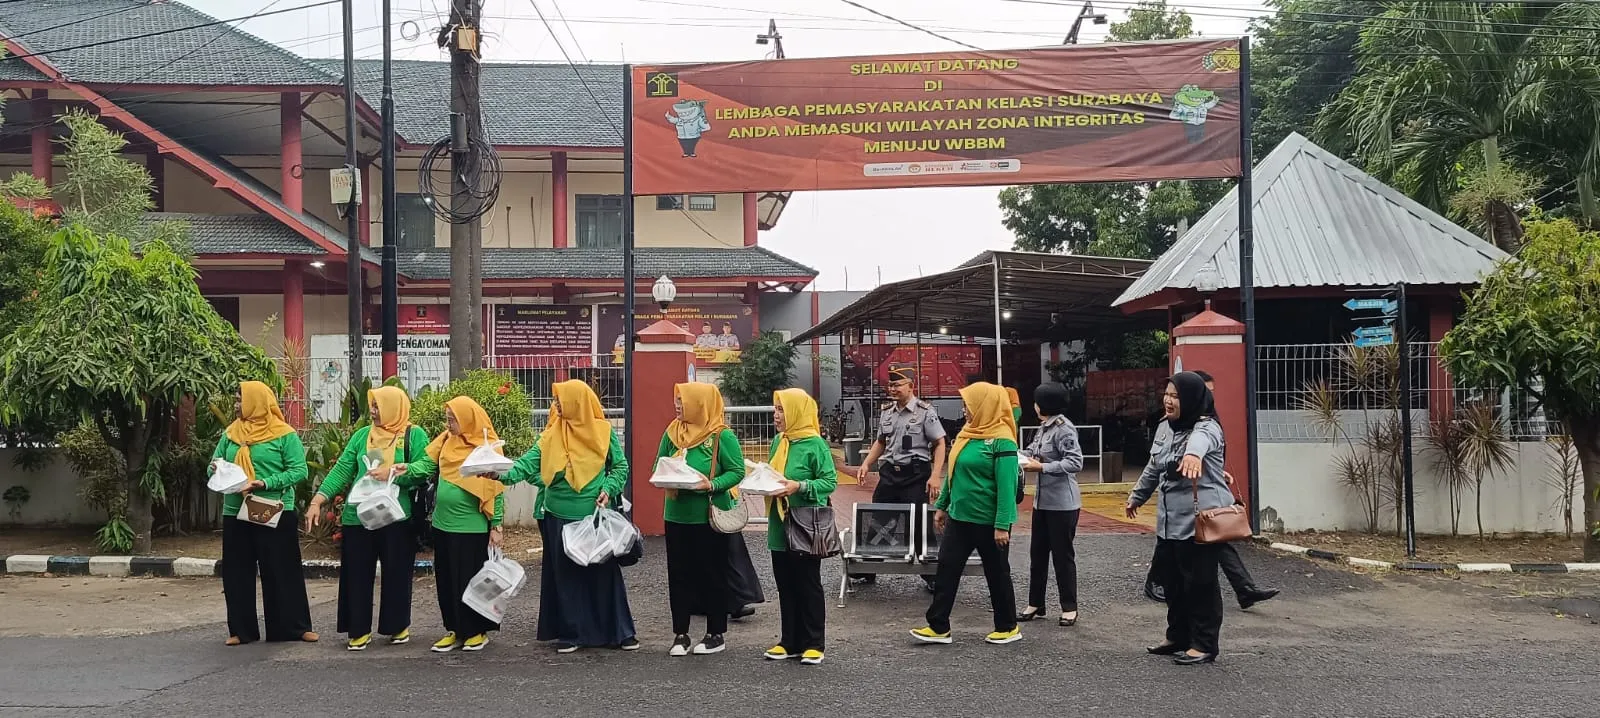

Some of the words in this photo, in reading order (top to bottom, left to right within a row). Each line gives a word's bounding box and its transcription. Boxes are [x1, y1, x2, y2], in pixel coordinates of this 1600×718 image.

[850, 60, 935, 75] SELAMAT
[939, 58, 1018, 72] DATANG
[924, 80, 943, 92] DI
[715, 105, 801, 120] LEMBAGA
[805, 98, 982, 116] PEMASYARAKATAN
[987, 96, 1044, 110] KELAS
[1047, 96, 1053, 107] I
[1057, 92, 1163, 107] SURABAYA
[728, 125, 780, 139] ANDA
[784, 121, 882, 137] MEMASUKI
[886, 118, 972, 133] WILAYAH
[976, 116, 1029, 130] ZONA
[1034, 112, 1145, 128] INTEGRITAS
[864, 139, 941, 153] MENUJU
[944, 137, 1005, 150] WBBM
[396, 338, 450, 349] PENGAYOMAN
